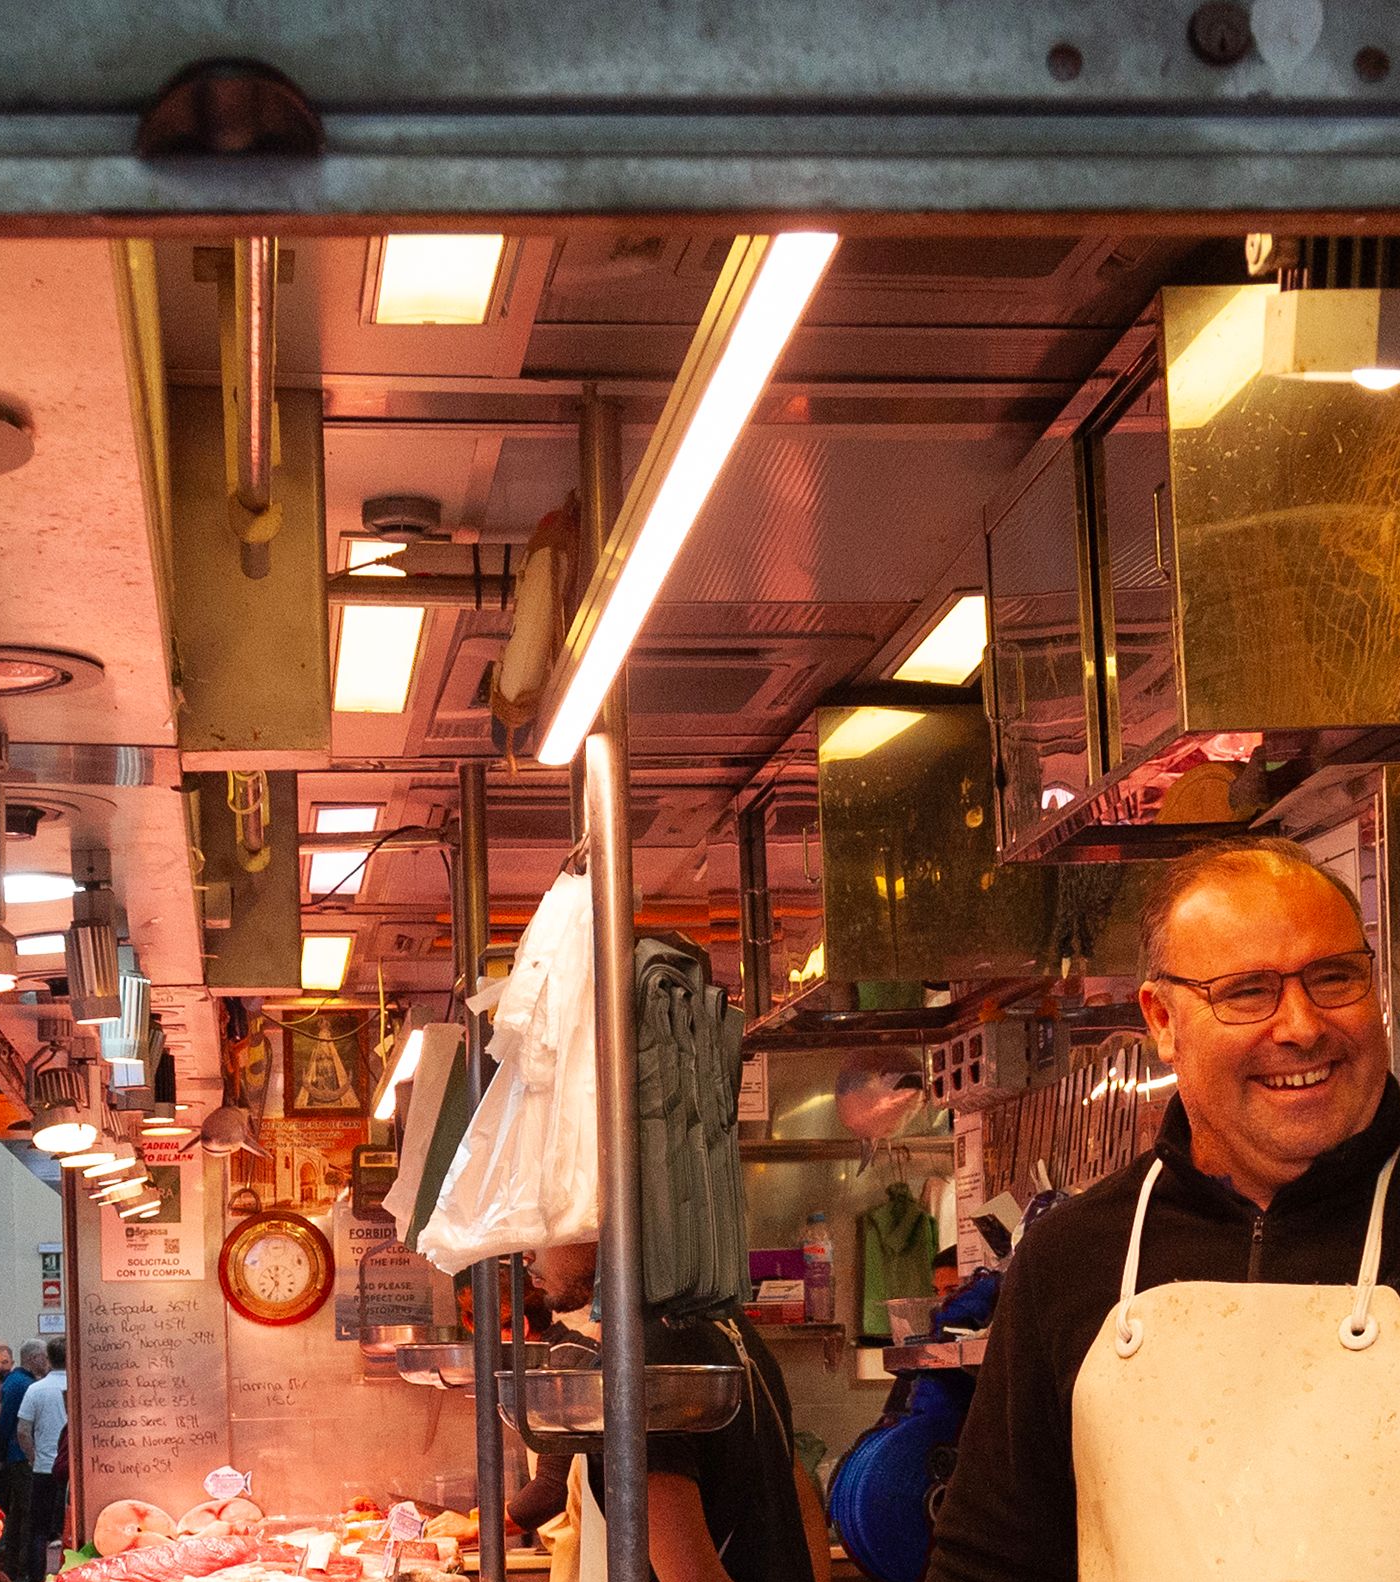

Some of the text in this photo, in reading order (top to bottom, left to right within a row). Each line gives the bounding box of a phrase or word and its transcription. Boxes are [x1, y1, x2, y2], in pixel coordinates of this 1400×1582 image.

[156, 1154, 194, 1162] BELMAN
[127, 1258, 180, 1267] SOLICITALO
[370, 1258, 387, 1266] THE
[390, 1258, 410, 1266] FISH
[116, 1268, 192, 1278] CON TU COMPRA
[395, 1294, 415, 1302] OUR
[109, 1300, 157, 1320] Espada
[91, 1434, 137, 1449] Merluza
